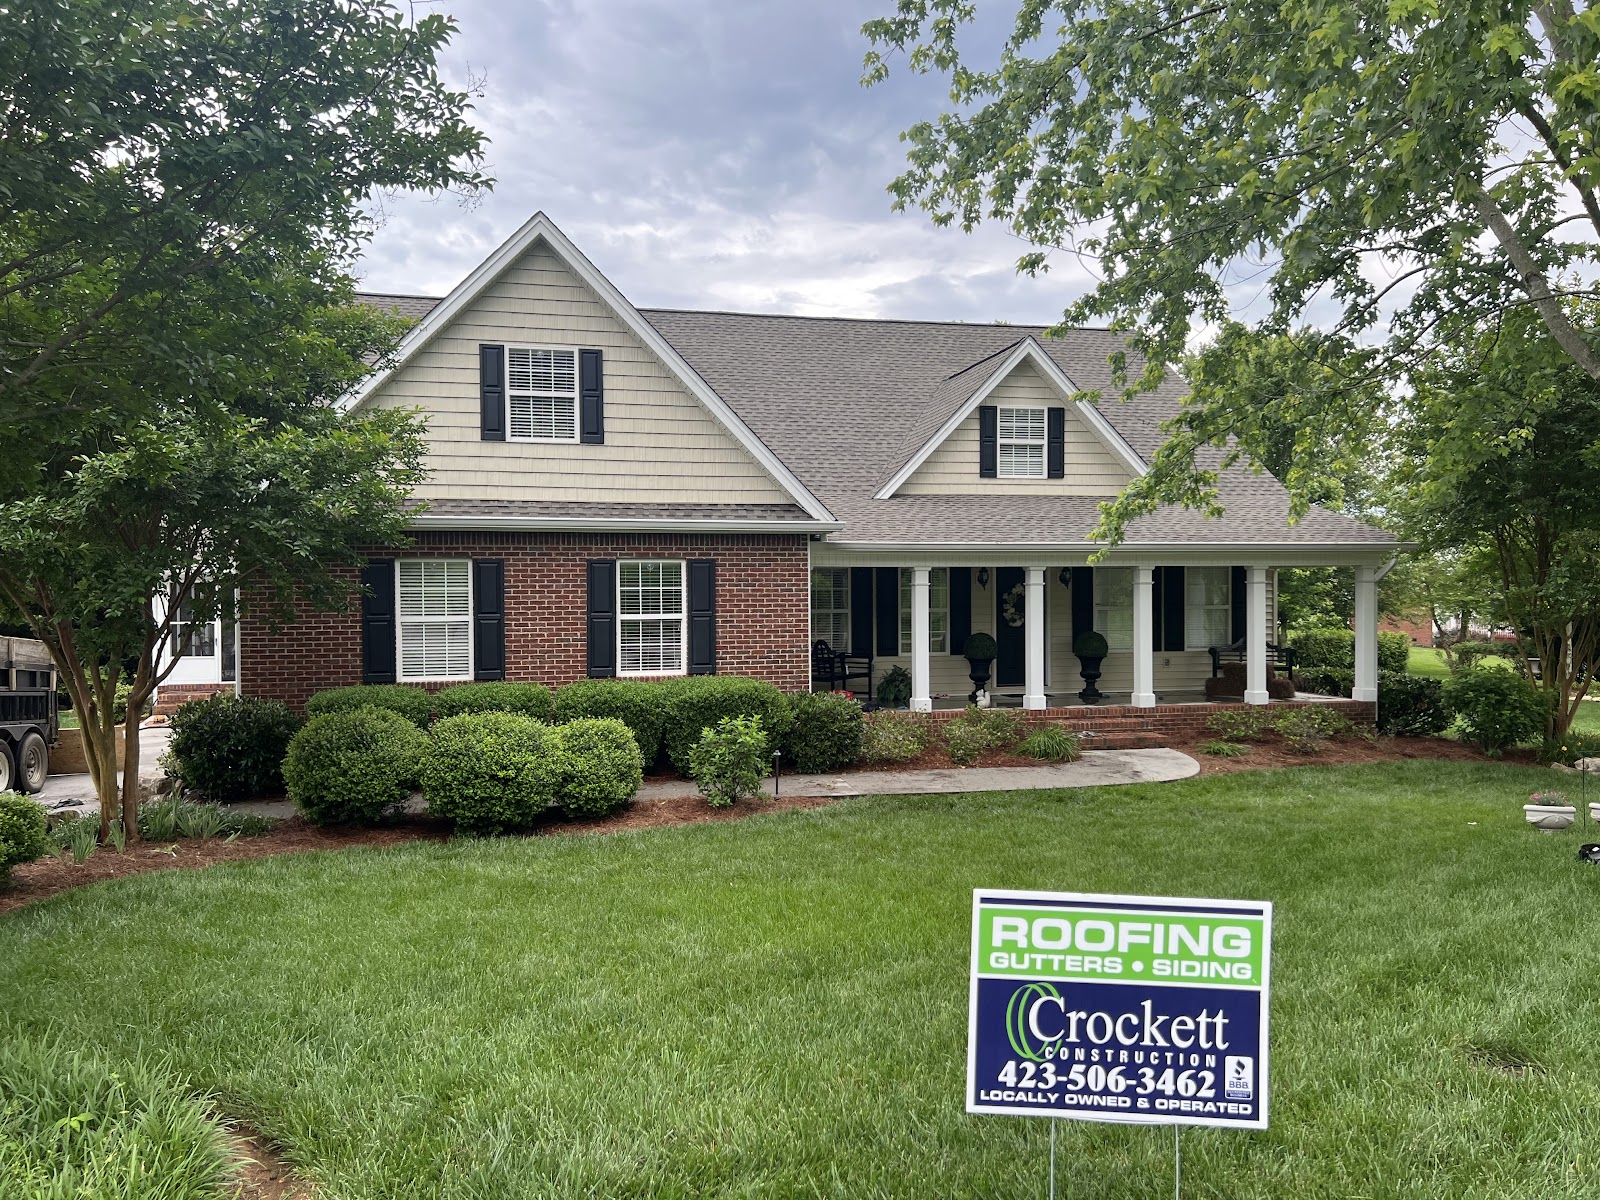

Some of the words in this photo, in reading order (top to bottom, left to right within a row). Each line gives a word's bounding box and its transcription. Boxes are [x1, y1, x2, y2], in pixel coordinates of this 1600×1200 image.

[991, 916, 1252, 958] ROOFING
[989, 952, 1123, 974] GUTTERS
[1152, 960, 1253, 980] SIDING
[1028, 996, 1229, 1050] Crockett
[1045, 1046, 1217, 1068] CONSTRUCTION
[998, 1061, 1216, 1098] 423-506-3462
[1228, 1081, 1249, 1089] BBB
[980, 1089, 1060, 1105] LOCALLY
[1064, 1094, 1132, 1109] OWNED
[1137, 1097, 1150, 1109] &
[1155, 1098, 1253, 1115] OPERATED
